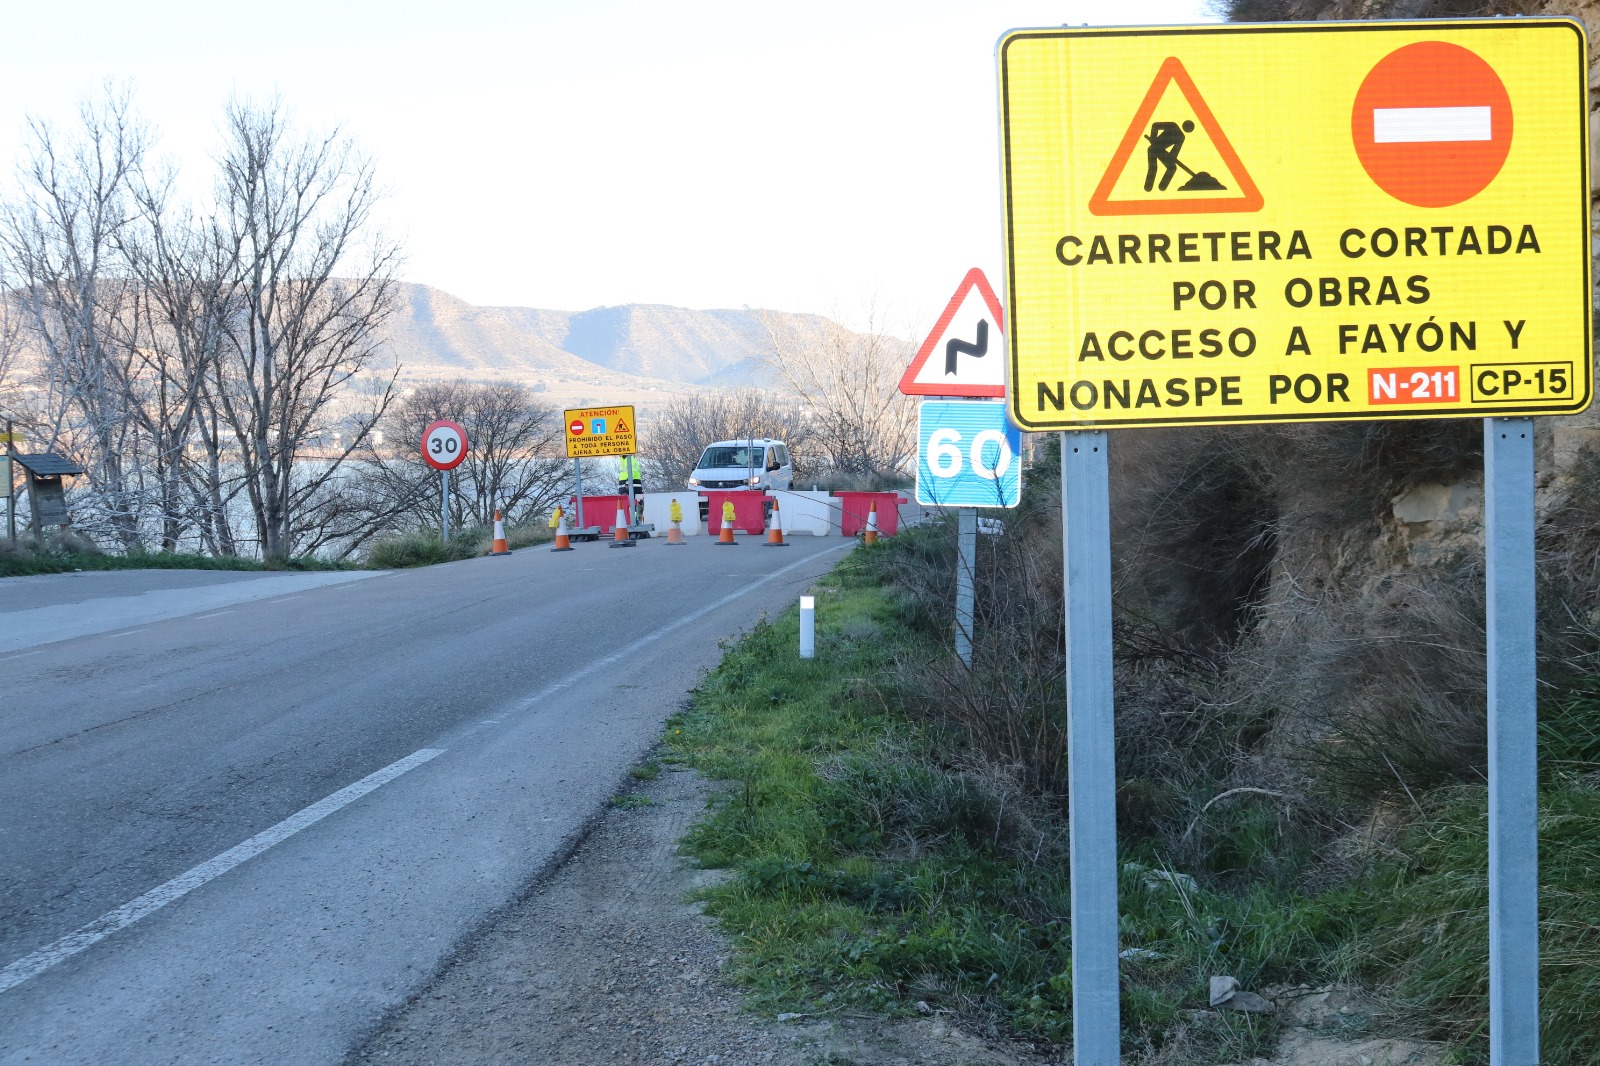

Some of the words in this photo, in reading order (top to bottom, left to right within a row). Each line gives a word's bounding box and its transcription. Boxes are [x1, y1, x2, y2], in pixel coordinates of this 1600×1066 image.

[1055, 229, 1313, 266] CARRETERA
[1339, 224, 1542, 260] CORTADA
[1173, 278, 1256, 311] POR
[1284, 275, 1430, 308] OBRAS
[1078, 326, 1257, 362] ACCESO
[1285, 326, 1312, 356] A
[1338, 316, 1477, 354] FAYÓN
[1503, 319, 1527, 349] Y
[1037, 375, 1243, 412] NONASPE
[1269, 372, 1350, 405] POR
[1371, 371, 1457, 401] N-211
[1476, 367, 1568, 396] CP-15
[431, 437, 458, 454] 30
[927, 428, 1012, 480] 60
